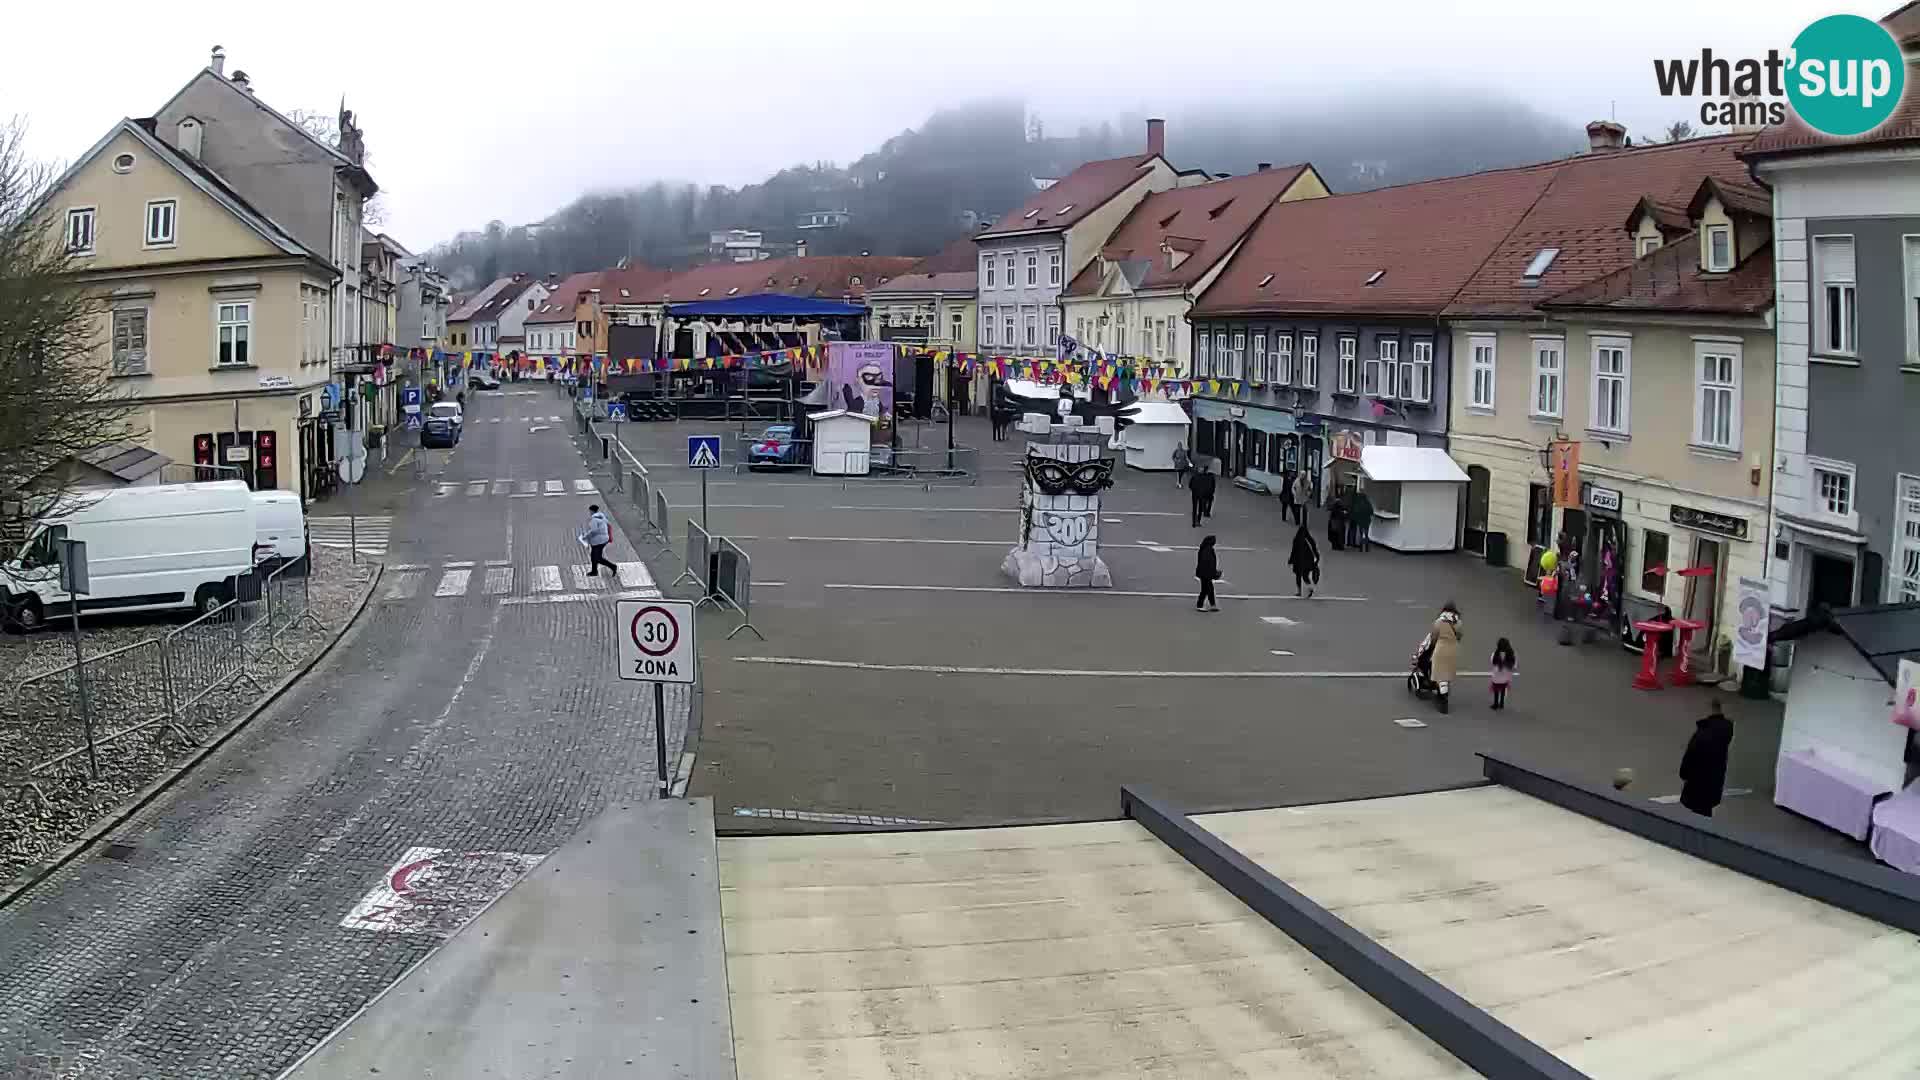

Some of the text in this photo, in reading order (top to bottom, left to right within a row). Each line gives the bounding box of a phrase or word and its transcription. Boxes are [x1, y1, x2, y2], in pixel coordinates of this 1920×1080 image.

[1047, 516, 1088, 545] 200
[644, 622, 668, 642] 30
[634, 659, 679, 676] ZONA
